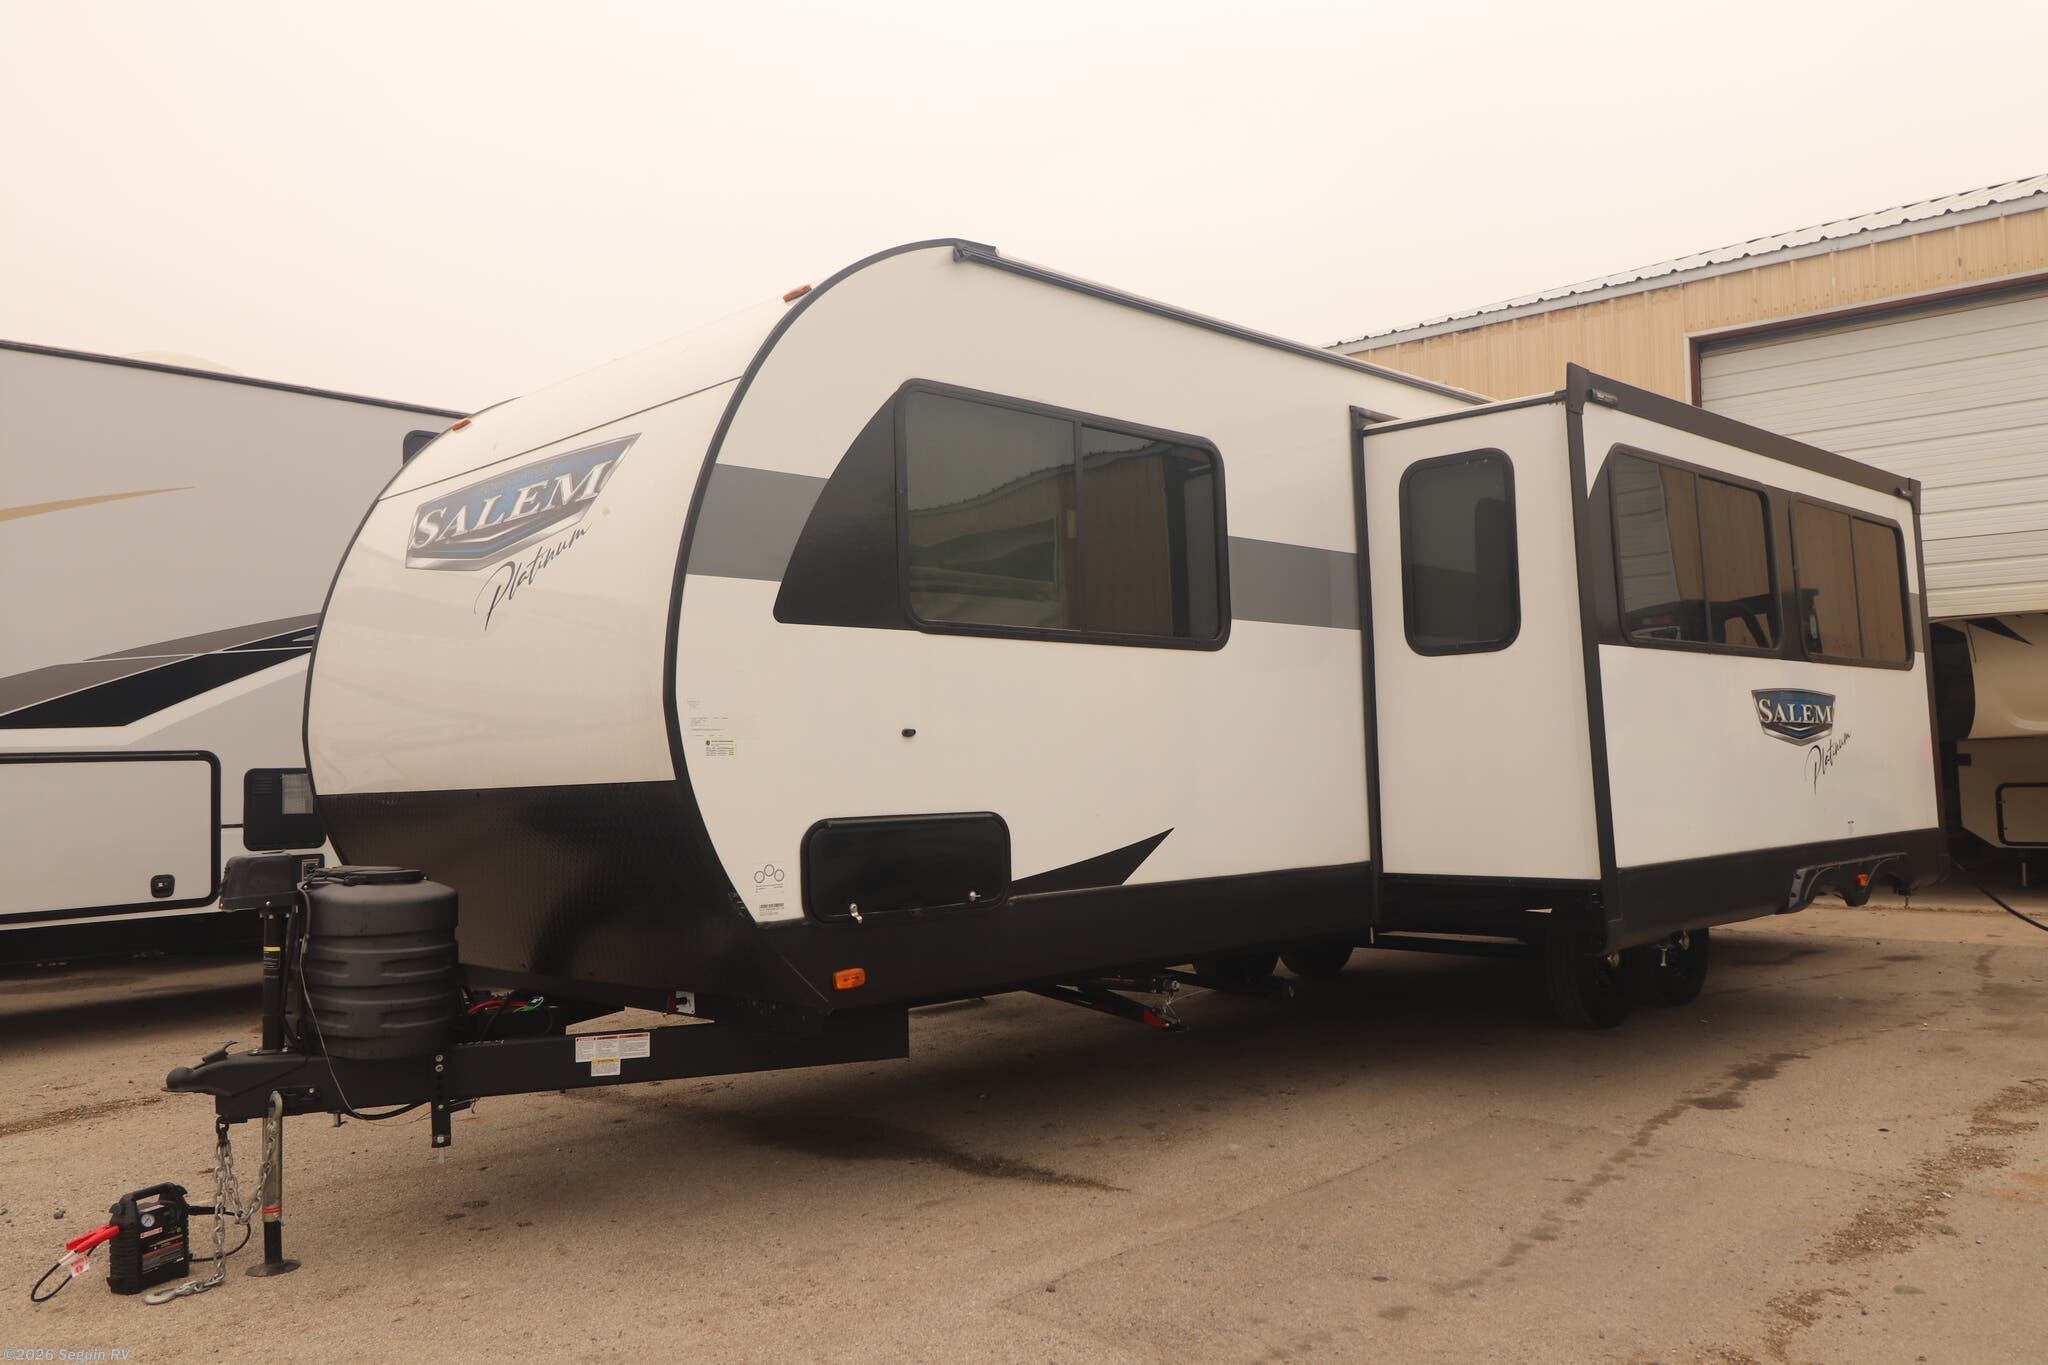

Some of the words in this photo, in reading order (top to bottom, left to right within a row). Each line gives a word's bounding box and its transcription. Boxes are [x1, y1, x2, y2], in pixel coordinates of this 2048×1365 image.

[408, 459, 613, 549] SALEM
[474, 522, 592, 632] Platinum
[1758, 698, 1833, 724] SALEM
[1804, 732, 1851, 795] Platinum
